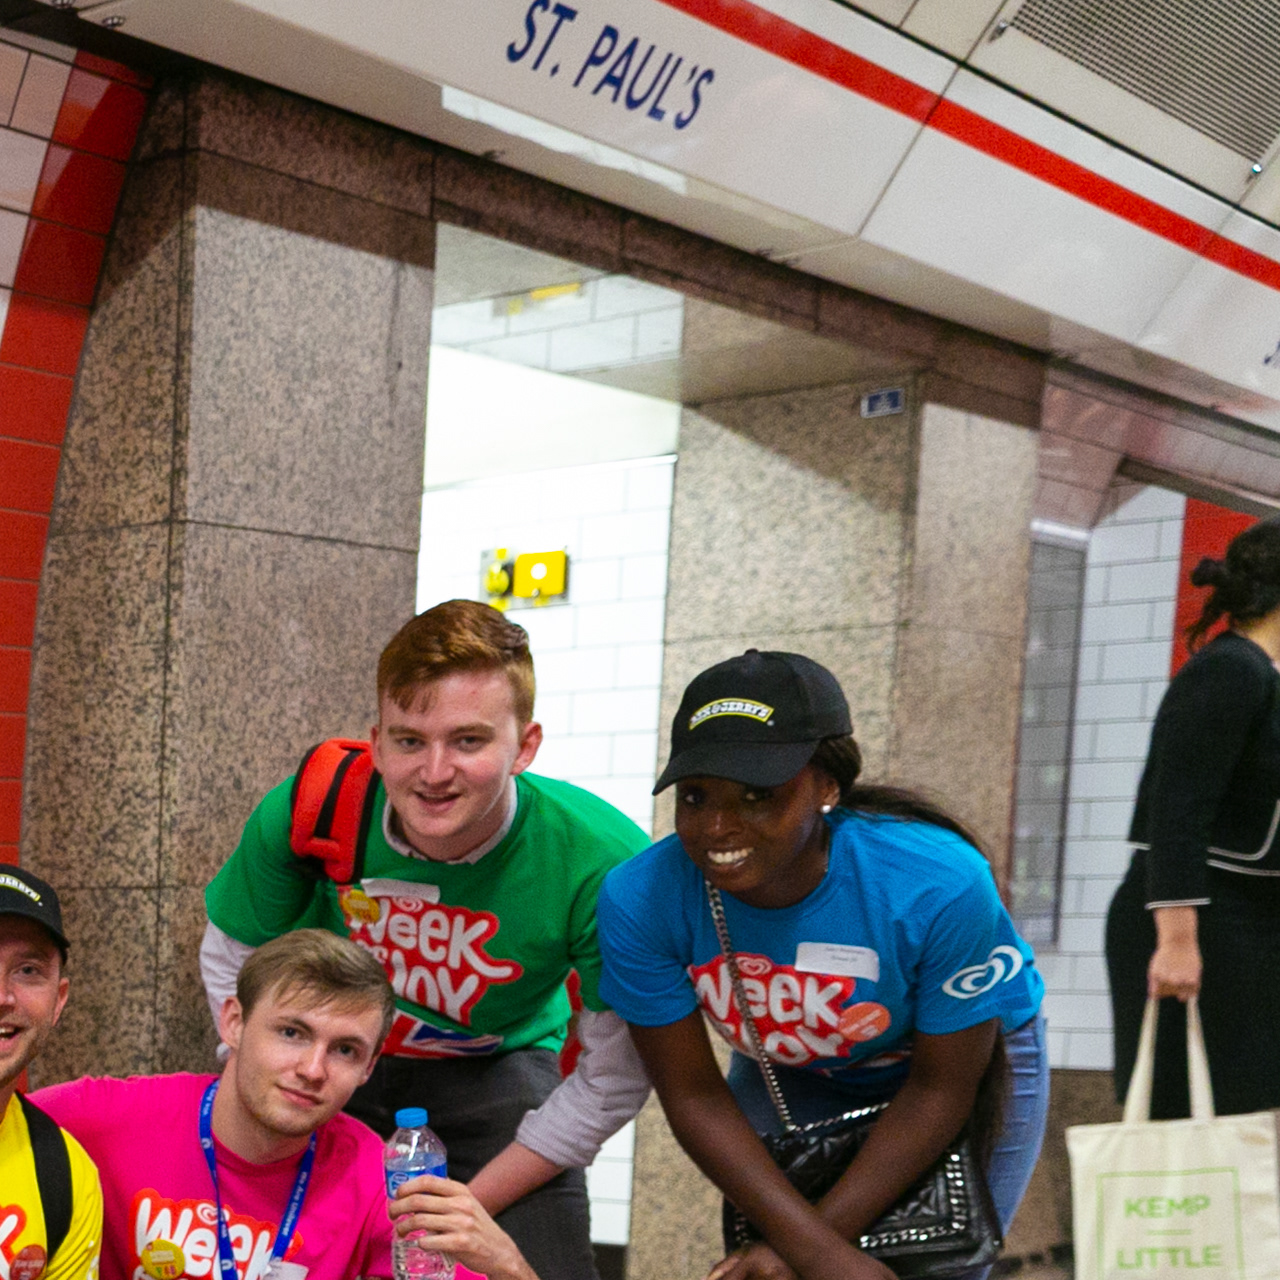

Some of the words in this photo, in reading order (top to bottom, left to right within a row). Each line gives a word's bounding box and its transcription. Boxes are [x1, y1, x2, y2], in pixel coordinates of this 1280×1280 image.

[507, 0, 578, 77] ST.
[573, 25, 715, 130] PAUL'S
[1124, 1194, 1211, 1219] KEMP
[1116, 1244, 1224, 1270] LITTLE
